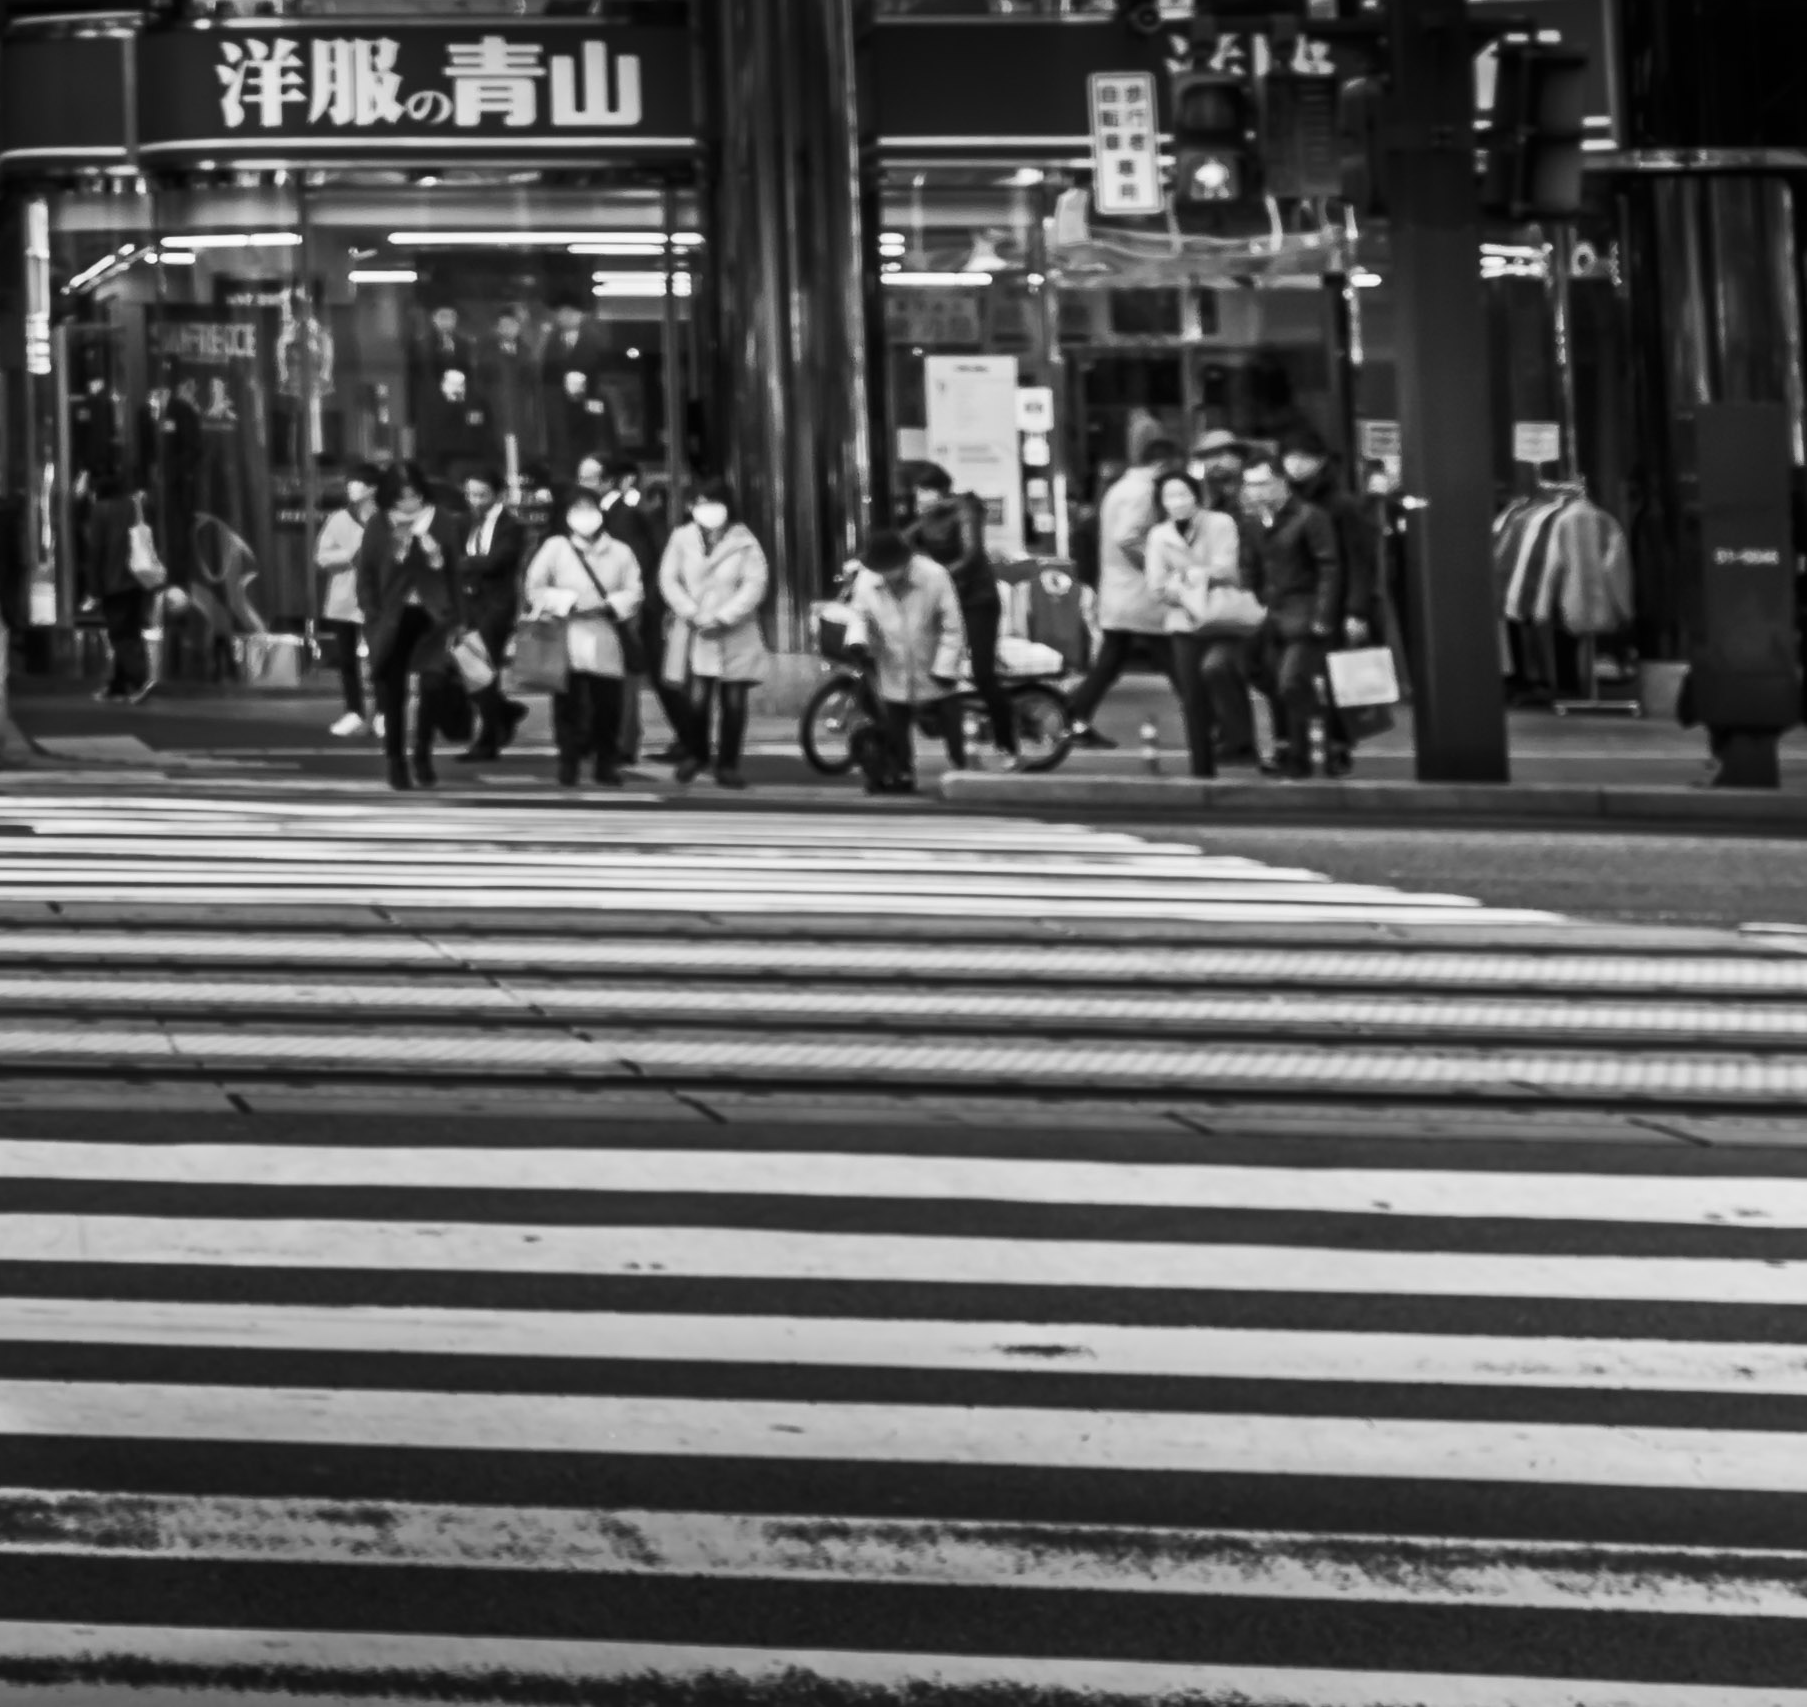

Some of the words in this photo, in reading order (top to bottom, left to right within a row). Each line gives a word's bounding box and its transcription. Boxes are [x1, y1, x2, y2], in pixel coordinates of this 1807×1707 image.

[216, 35, 643, 129] 洋服の青山
